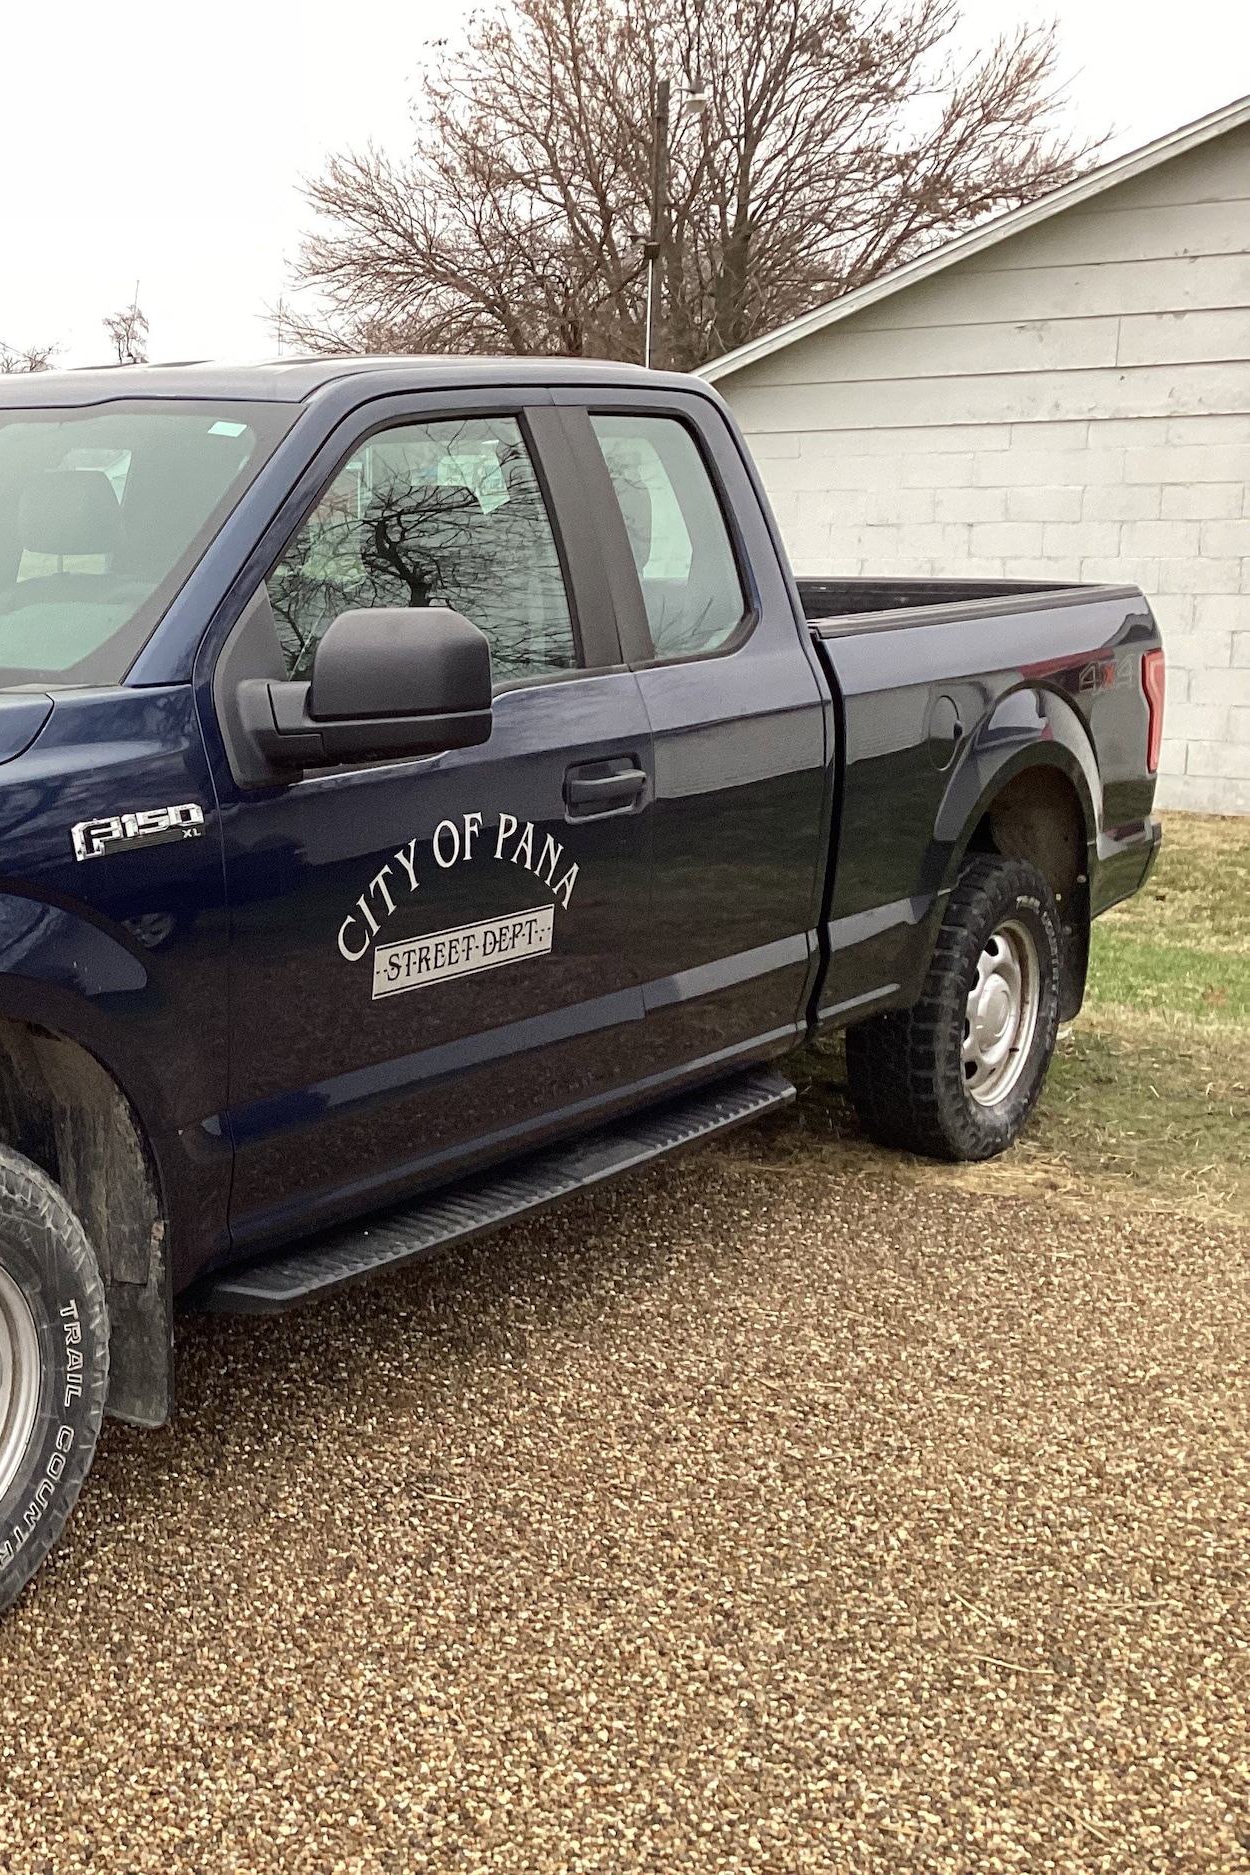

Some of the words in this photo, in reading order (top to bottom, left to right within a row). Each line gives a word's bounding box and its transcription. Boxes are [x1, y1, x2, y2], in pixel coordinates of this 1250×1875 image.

[181, 827, 202, 839] XL
[337, 838, 420, 962] CITY
[433, 812, 483, 869] OF
[494, 813, 580, 910] PANA
[386, 934, 476, 982] STREET
[58, 1299, 85, 1408] TRAIL
